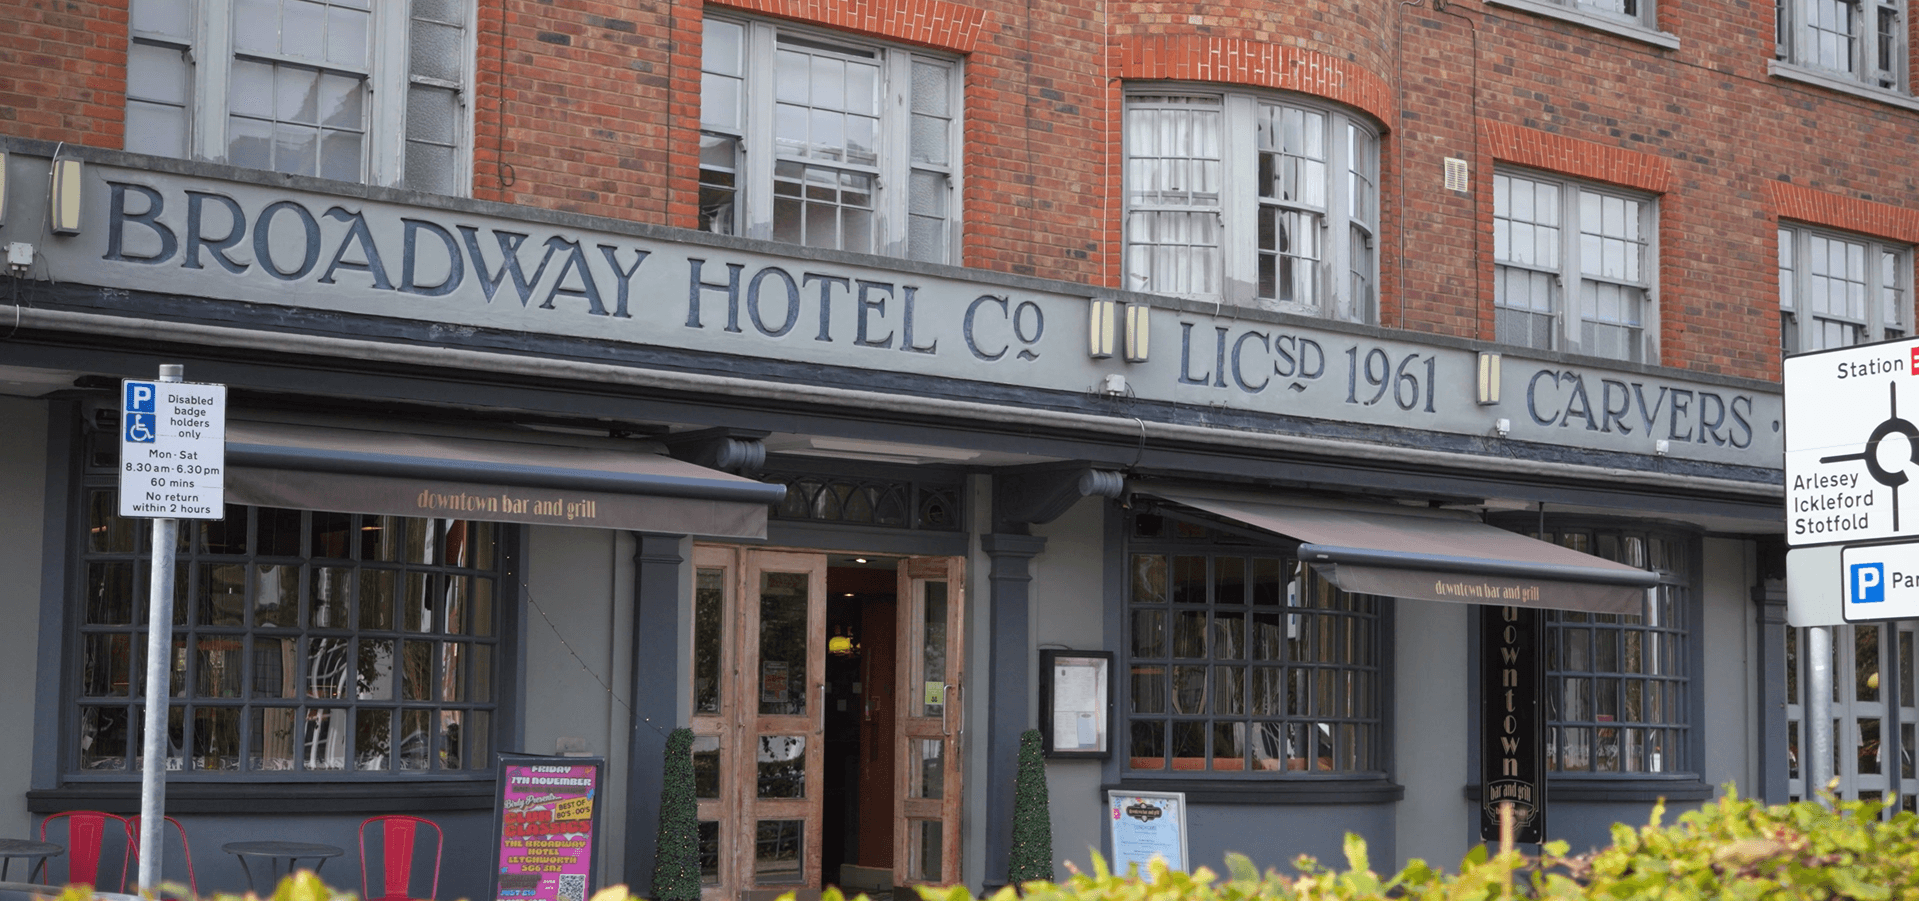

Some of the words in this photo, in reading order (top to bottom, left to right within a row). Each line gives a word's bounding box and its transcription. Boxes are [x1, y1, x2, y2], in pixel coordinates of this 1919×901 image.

[103, 181, 651, 318] BROADWAY
[685, 258, 937, 354] HOTEL
[1345, 343, 1436, 413] 1961
[1527, 369, 1752, 449] CARVERS
[1837, 358, 1903, 379] Station
[133, 386, 152, 409] P
[168, 394, 214, 406] Disabled
[174, 406, 206, 417] badge
[170, 417, 210, 428] holders
[178, 430, 201, 440] only
[150, 477, 166, 487] 60
[170, 479, 195, 488] mins
[1793, 473, 1859, 491] Arlesey
[146, 492, 161, 501] No
[165, 493, 199, 502] return
[1794, 489, 1874, 513] Ickleford
[133, 503, 166, 513] within
[170, 504, 177, 512] 2
[181, 504, 211, 514] hours
[417, 489, 497, 512] downtown
[502, 495, 529, 513] bar
[533, 499, 562, 516] and
[567, 499, 596, 521] grill
[1795, 512, 1869, 535] Stotfold
[1858, 567, 1880, 600] P
[1435, 580, 1483, 598] downtown
[1484, 583, 1500, 598] bar
[1503, 585, 1520, 600] and
[1522, 586, 1540, 603] grill
[532, 777, 592, 786] NOVEMBER
[1490, 785, 1502, 801] bar
[1503, 782, 1517, 798] and
[1518, 784, 1531, 802] grill
[558, 801, 575, 811] BEST
[576, 799, 586, 807] OF
[505, 821, 590, 836] CLASSICS
[525, 840, 586, 848] BROADWAY
[527, 848, 559, 856] HOTEL
